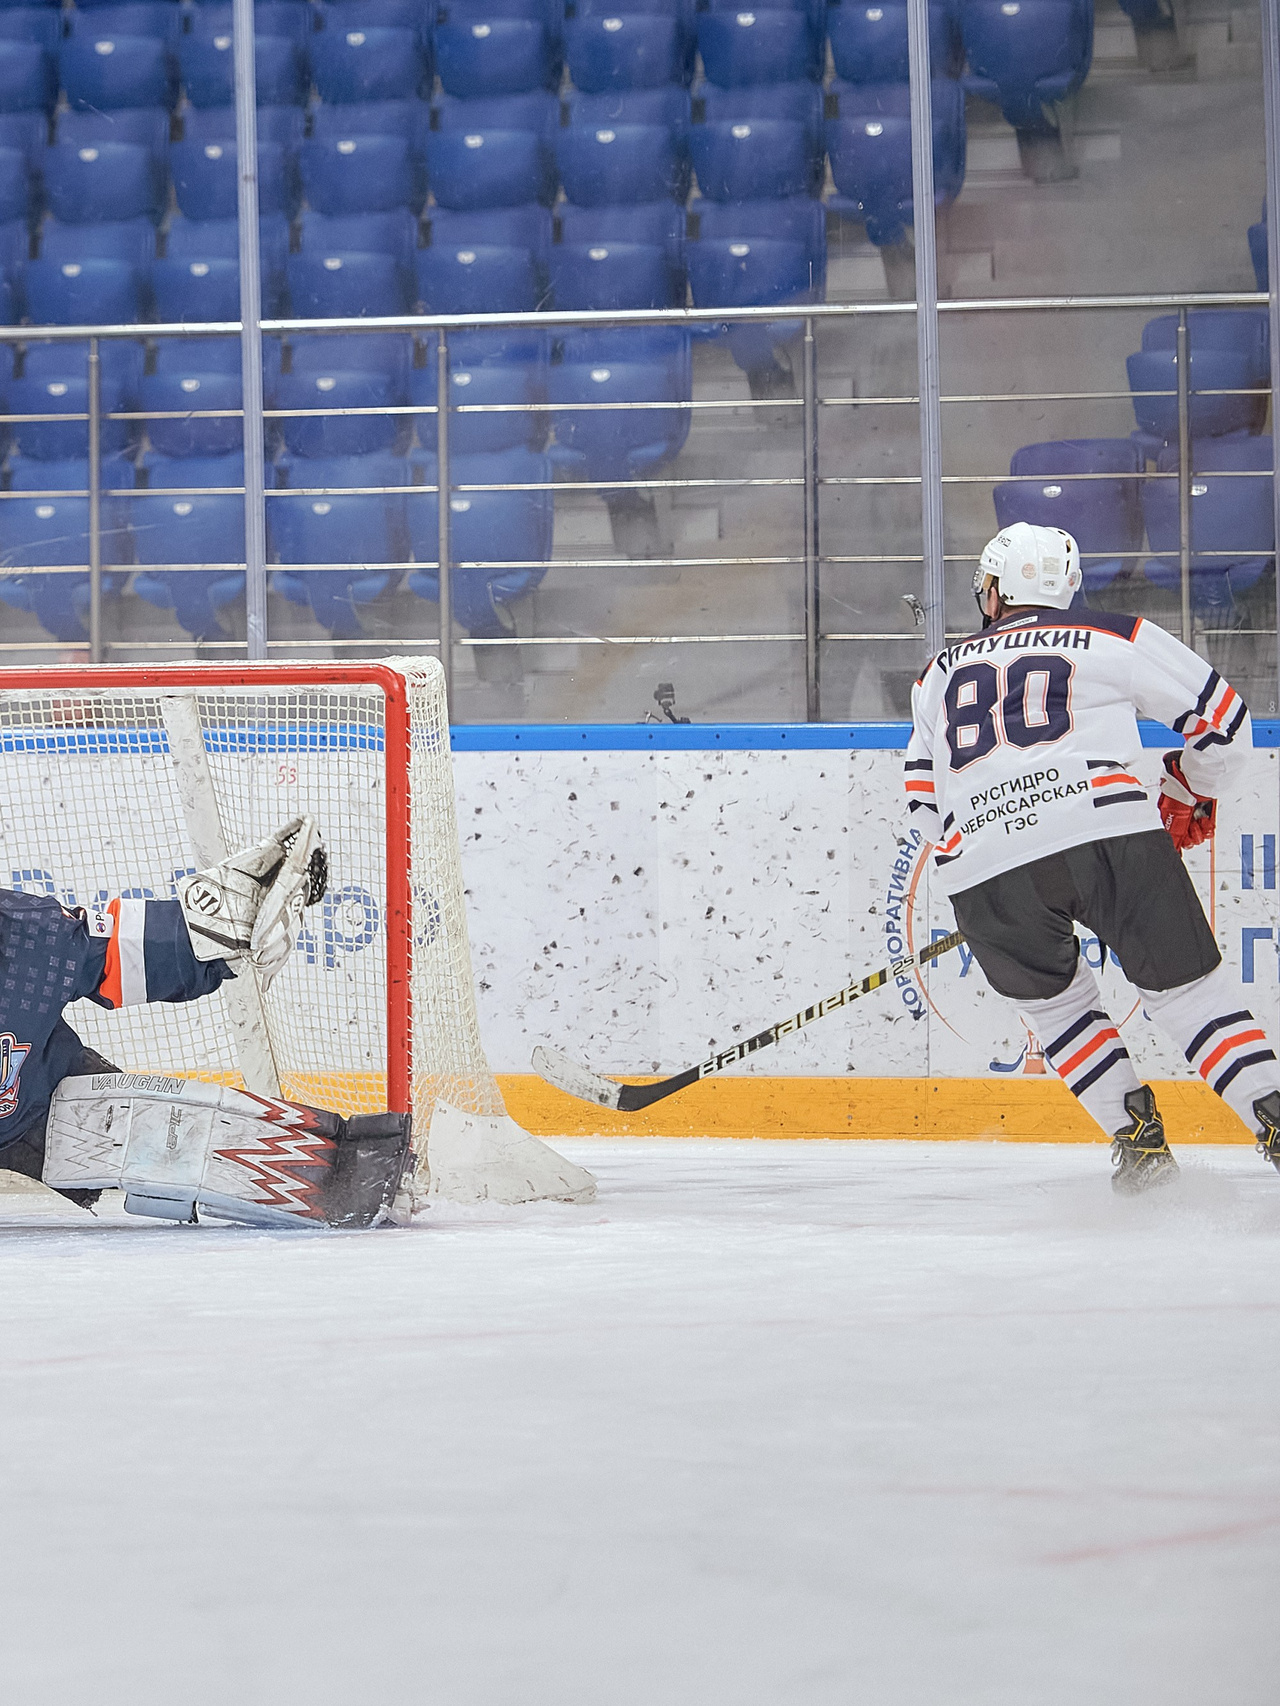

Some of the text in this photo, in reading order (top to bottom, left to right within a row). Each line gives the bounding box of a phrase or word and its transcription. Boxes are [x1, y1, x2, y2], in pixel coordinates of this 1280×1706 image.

[943, 652, 1077, 774] 80
[960, 780, 1090, 836] ЧЕБОКСАРСКАЯ
[970, 768, 1060, 811] РУСГИДРО
[1004, 813, 1040, 835] ГЭС
[91, 1073, 187, 1095] VAUGHN
